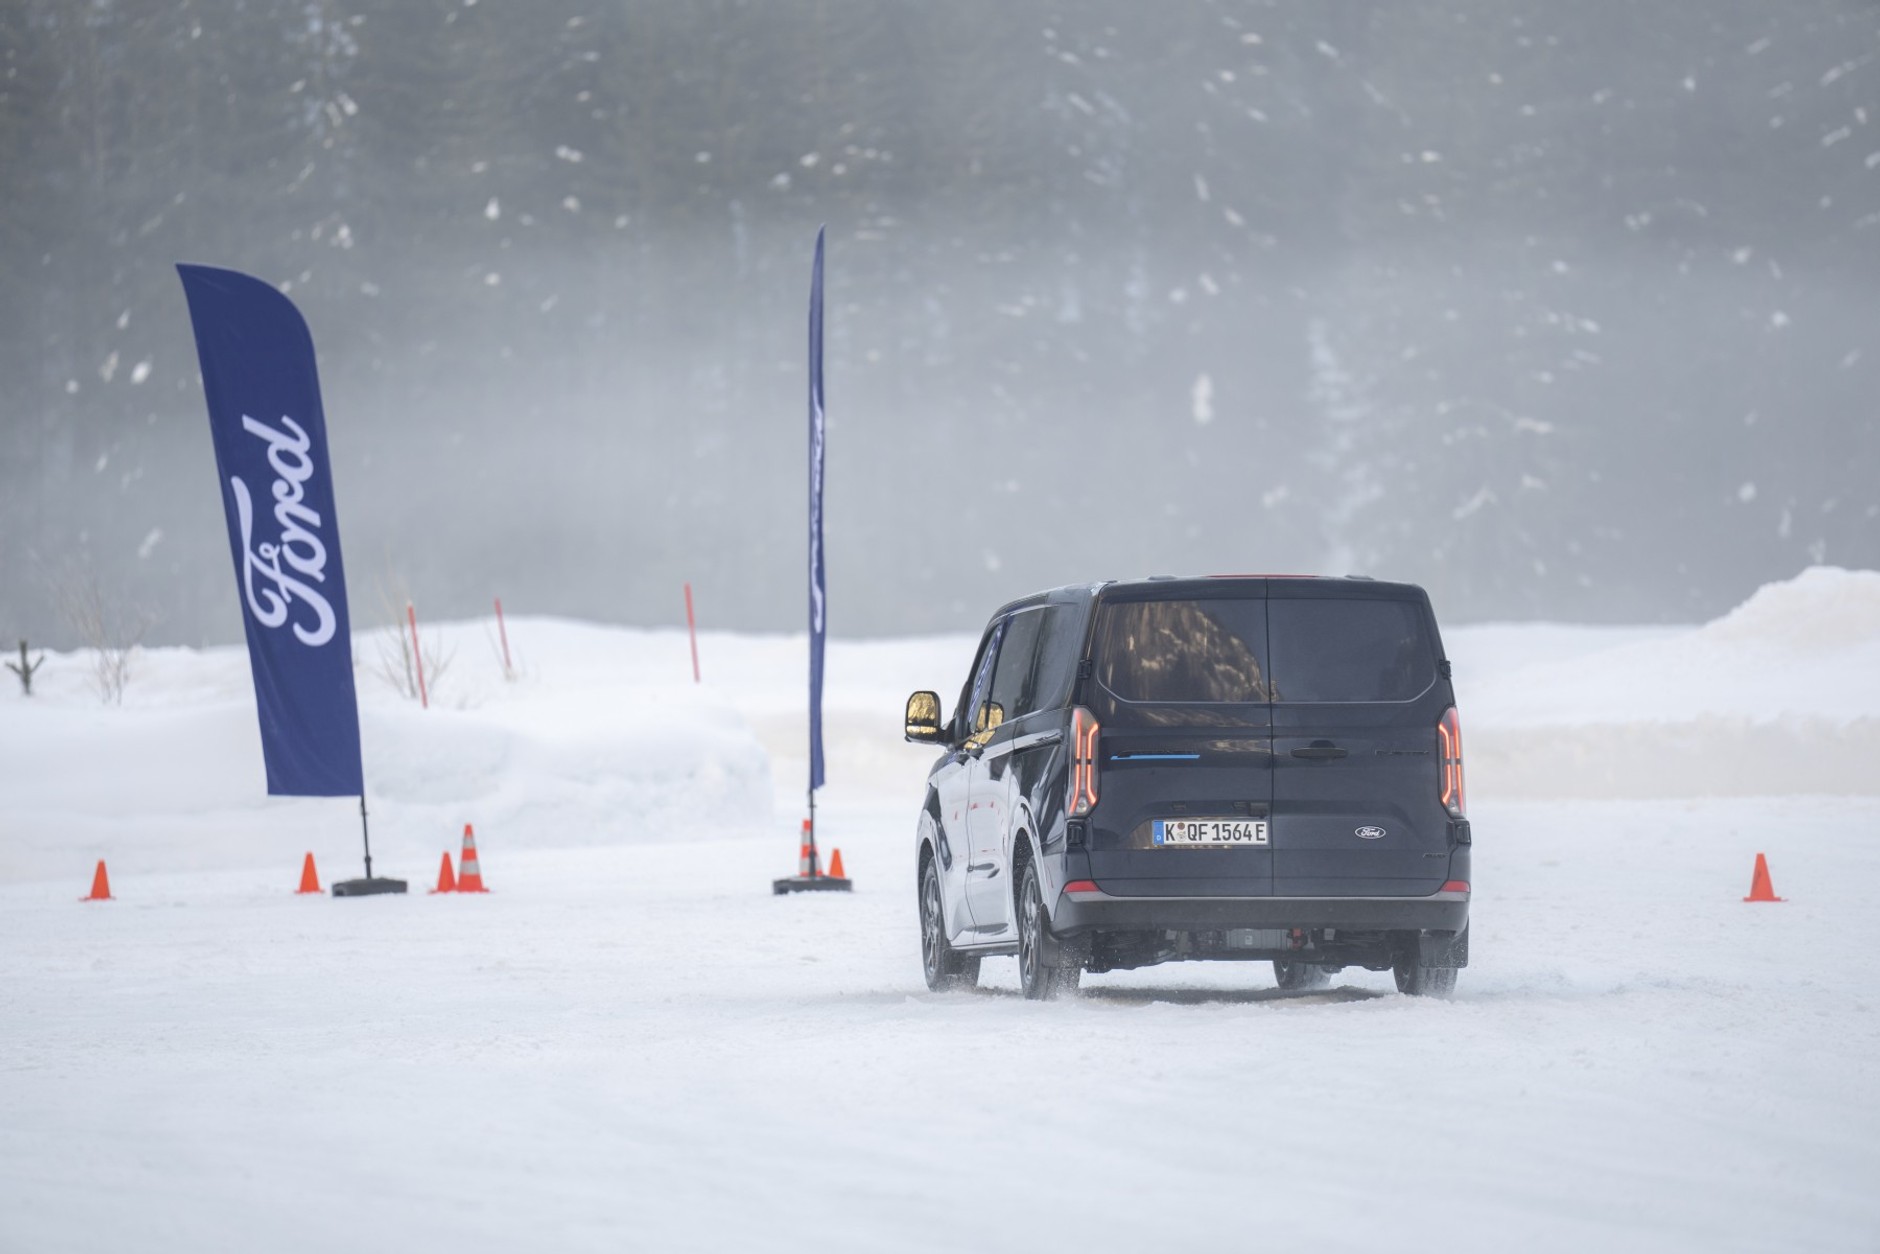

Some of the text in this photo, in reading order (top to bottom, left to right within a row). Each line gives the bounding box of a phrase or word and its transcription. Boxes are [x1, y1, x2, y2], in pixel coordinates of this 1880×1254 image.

[231, 414, 336, 646] Ford
[1165, 823, 1176, 841] K
[1187, 823, 1208, 841] QF
